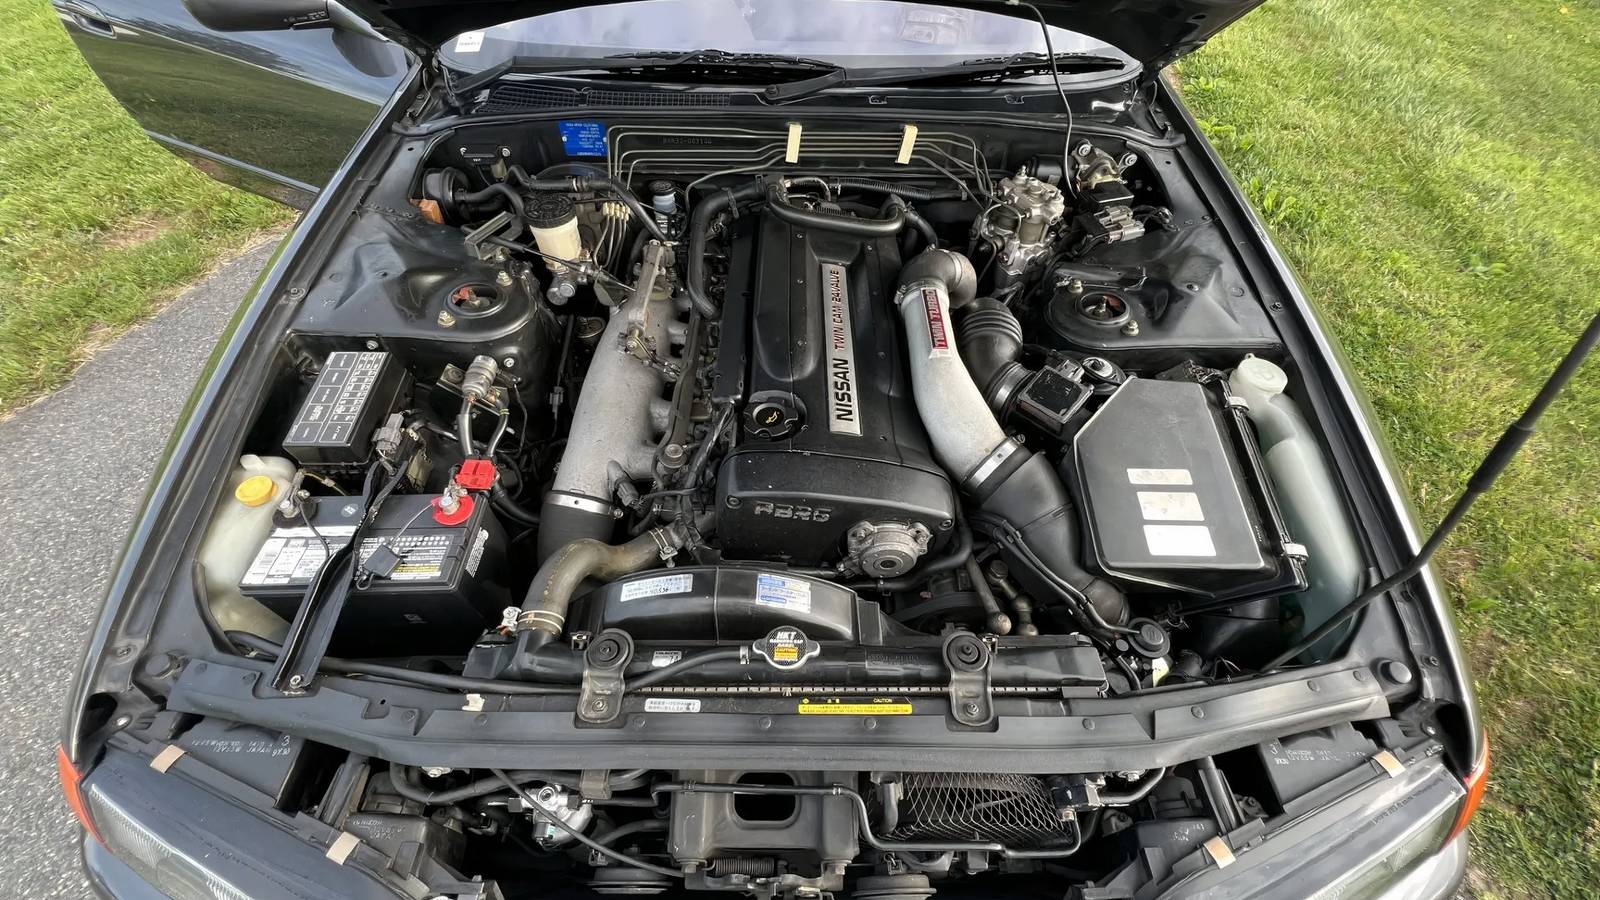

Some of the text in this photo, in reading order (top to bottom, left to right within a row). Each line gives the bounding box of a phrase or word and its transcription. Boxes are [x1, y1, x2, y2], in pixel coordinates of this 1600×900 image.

[833, 306, 843, 323] CAM
[926, 289, 946, 347] TWIN TURBO
[833, 327, 845, 349] TWIN
[833, 358, 853, 421] NISSAN
